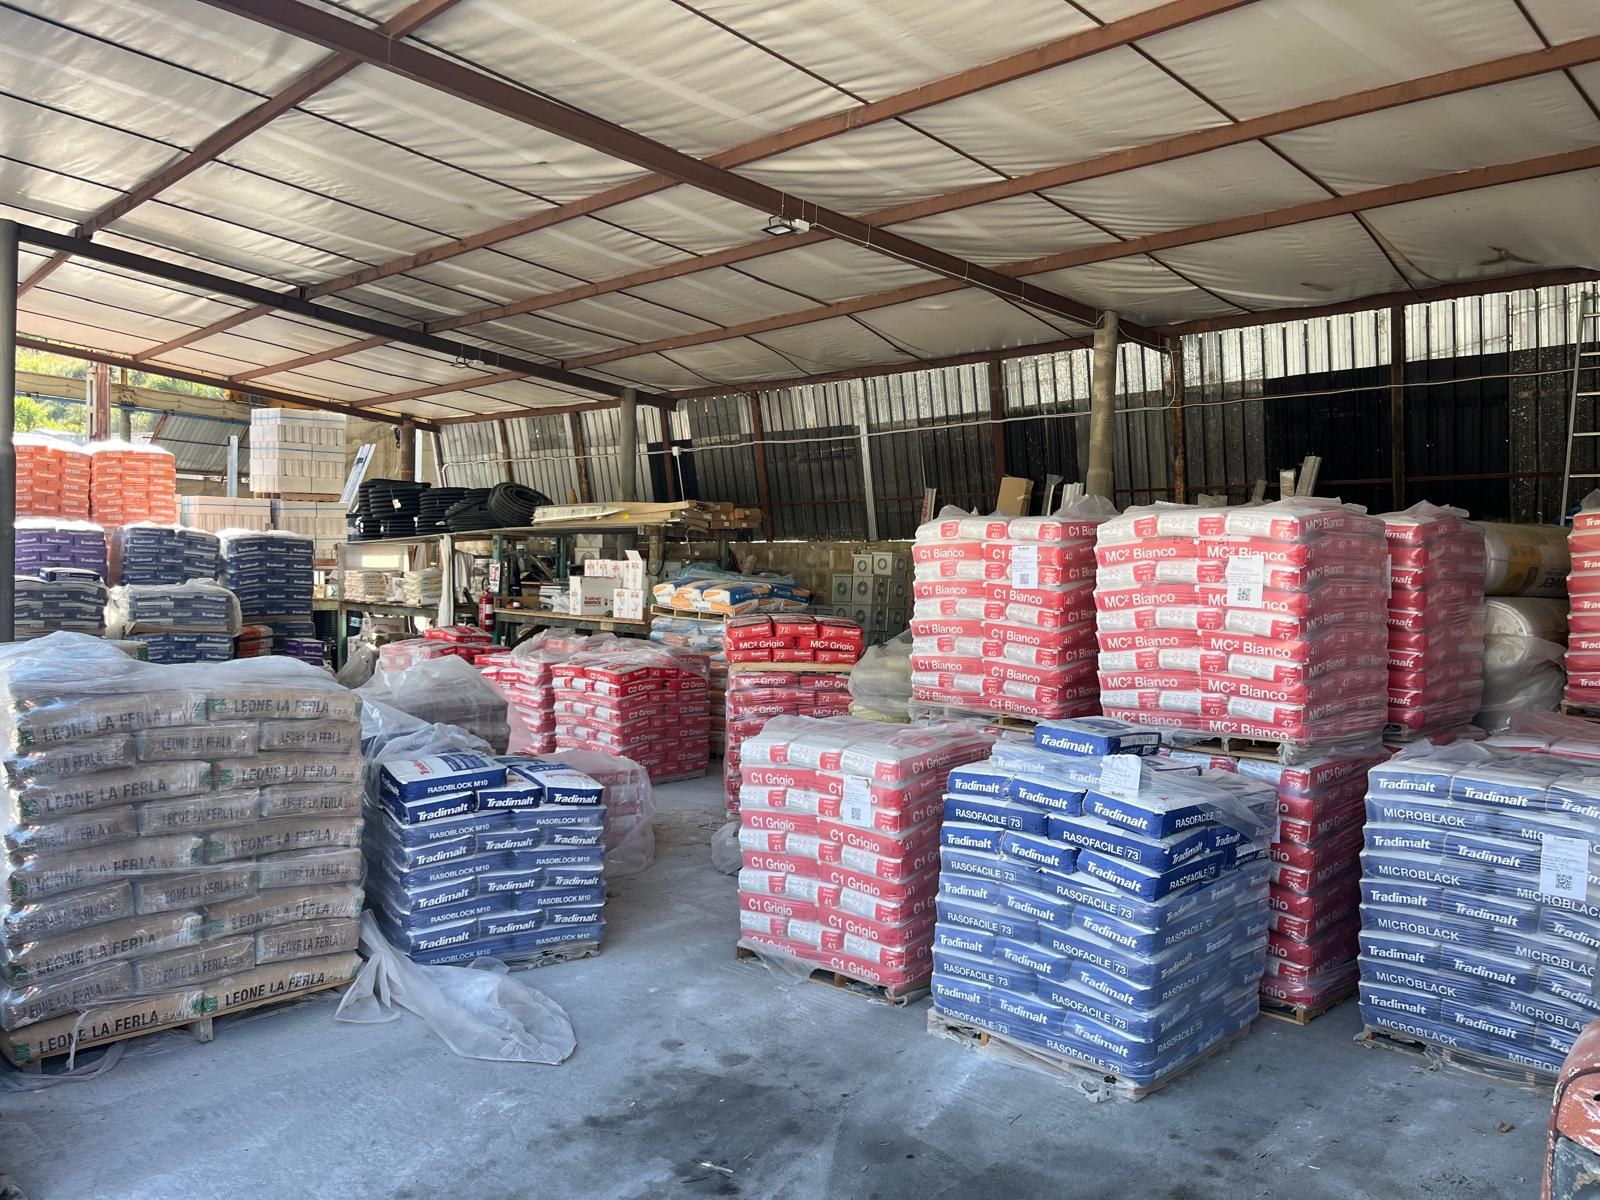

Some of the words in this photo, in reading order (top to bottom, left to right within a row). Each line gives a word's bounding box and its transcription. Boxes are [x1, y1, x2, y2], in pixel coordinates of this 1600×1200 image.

[1142, 528, 1151, 536] 47
[1206, 527, 1216, 536] 47
[920, 551, 931, 559] C1
[933, 549, 964, 558] Bianco
[1065, 553, 1073, 561] 40
[1134, 548, 1176, 560] Bianco
[921, 587, 933, 595] C1
[935, 586, 967, 595] Bianco
[994, 589, 1006, 599] C1
[1010, 591, 1042, 605] Bianco
[1132, 593, 1175, 604] Bianco
[918, 625, 930, 633] C1
[932, 624, 963, 633] Bianco
[991, 629, 1003, 638] C1
[1007, 631, 1039, 645] Bianco
[759, 640, 784, 648] Grigio
[830, 642, 854, 650] Grigio
[1136, 636, 1178, 647] Bianco
[1243, 641, 1291, 658] Bianco
[918, 660, 930, 669] C1
[932, 660, 962, 671] Bianco
[991, 667, 1004, 676] C1
[1007, 670, 1040, 684] Bianco
[1135, 676, 1178, 688] Bianco
[628, 685, 637, 693] C2
[1240, 684, 1287, 700] Bianco
[234, 701, 272, 713] LEONE
[276, 700, 290, 711] LA
[294, 701, 330, 714] FERLA
[1209, 706, 1219, 714] 47
[44, 720, 97, 742] LEONE
[97, 715, 115, 731] LA
[1241, 724, 1288, 740] Bianco
[1041, 734, 1094, 754] Tradimalt
[241, 768, 281, 783] LEONE
[284, 767, 298, 780] LA
[301, 766, 337, 779] FERLA
[751, 772, 763, 783] C1
[765, 773, 794, 786] Grigio
[427, 782, 473, 794] RASOBLOCK
[473, 779, 488, 788] M10
[954, 779, 1000, 794] Tradimalt
[1378, 778, 1436, 792] Tradimalt
[46, 790, 95, 811] LEONE
[99, 785, 118, 801] LA
[122, 780, 166, 798] FERLA
[486, 796, 534, 808] Tradimalt
[553, 794, 597, 804] Tradimalt
[1018, 788, 1068, 810] Tradimalt
[1464, 786, 1528, 807] Tradimalt
[417, 803, 468, 821] Tradimalt
[955, 808, 1007, 825] RASOFACILE
[1010, 818, 1020, 827] 73
[1094, 802, 1148, 830] Tradimalt
[1384, 808, 1466, 827] MICROBLACK
[429, 826, 475, 840] RASOBLOCK
[476, 824, 489, 832] M10
[751, 816, 763, 827] C1
[766, 817, 794, 831] Grigio
[485, 838, 533, 851] Tradimalt
[554, 835, 597, 844] Tradimalt
[830, 830, 844, 842] C1
[848, 833, 880, 851] Grigio
[947, 834, 992, 849] Tradimalt
[1063, 830, 1124, 856] RASOFACILE
[1128, 849, 1139, 860] 73
[1373, 836, 1430, 849] Tradimalt
[416, 846, 467, 865] Tradimalt
[1011, 842, 1060, 867] Tradimalt
[1457, 845, 1521, 868] Tradimalt
[429, 867, 475, 881] RASOBLOCK
[476, 864, 489, 873] M10
[752, 857, 763, 868] C1
[766, 859, 795, 872] Grigio
[951, 860, 1001, 879] RASOFACILE
[1004, 872, 1014, 881] 73
[555, 876, 598, 886] Tradimalt
[831, 872, 844, 885] C1
[847, 878, 880, 895] Grigio
[1087, 861, 1142, 892] Tradimalt
[1169, 868, 1206, 891] RASOFACILE
[1379, 865, 1460, 886] MICROBLACK
[487, 879, 535, 892] Tradimalt
[418, 889, 469, 909] Tradimalt
[538, 896, 578, 905] RASOBLOCK
[1371, 890, 1428, 906] Tradimalt
[431, 909, 475, 923] RASOBLOCK
[476, 906, 490, 914] M10
[749, 899, 761, 909] C1
[764, 900, 792, 916] Grigio
[1007, 896, 1055, 921] Tradimalt
[1455, 903, 1518, 926] Tradimalt
[554, 913, 597, 923] Tradimalt
[947, 912, 998, 932] RASOFACILE
[1001, 925, 1012, 934] 73
[488, 920, 535, 935] Tradimalt
[829, 915, 842, 927] C1
[847, 920, 878, 939] Grigio
[1083, 916, 1138, 948] Tradimalt
[1378, 918, 1459, 941] MICROBLACK
[419, 932, 469, 950] Tradimalt
[940, 934, 982, 952] Tradimalt
[1004, 948, 1052, 974] Tradimalt
[1052, 940, 1111, 968] RASOFACILE
[1114, 963, 1126, 974] 73
[1369, 945, 1425, 963] Tradimalt
[831, 957, 844, 969] C1
[847, 961, 880, 981] Grigio
[944, 963, 995, 982] RASOFACILE
[998, 977, 1009, 986] 73
[1454, 959, 1516, 984] Tradimalt
[224, 985, 265, 1006] LEONE
[269, 980, 284, 995] LA
[288, 972, 325, 992] FERLA
[1080, 971, 1135, 1005] Tradimalt
[1376, 971, 1457, 997] MICROBLACK
[936, 984, 981, 1003] Tradimalt
[1000, 999, 1048, 1024] Tradimalt
[1052, 993, 1111, 1021] RASOFACILE
[1114, 1017, 1126, 1028] 73
[1369, 995, 1426, 1014] Tradimalt
[39, 1029, 87, 1054] LEONE
[92, 1022, 110, 1039] LA
[115, 1010, 158, 1032] FERLA
[1377, 1017, 1457, 1046] MICROBLACK
[1455, 1012, 1518, 1039] Tradimalt
[1074, 1023, 1129, 1057] Tradimalt
